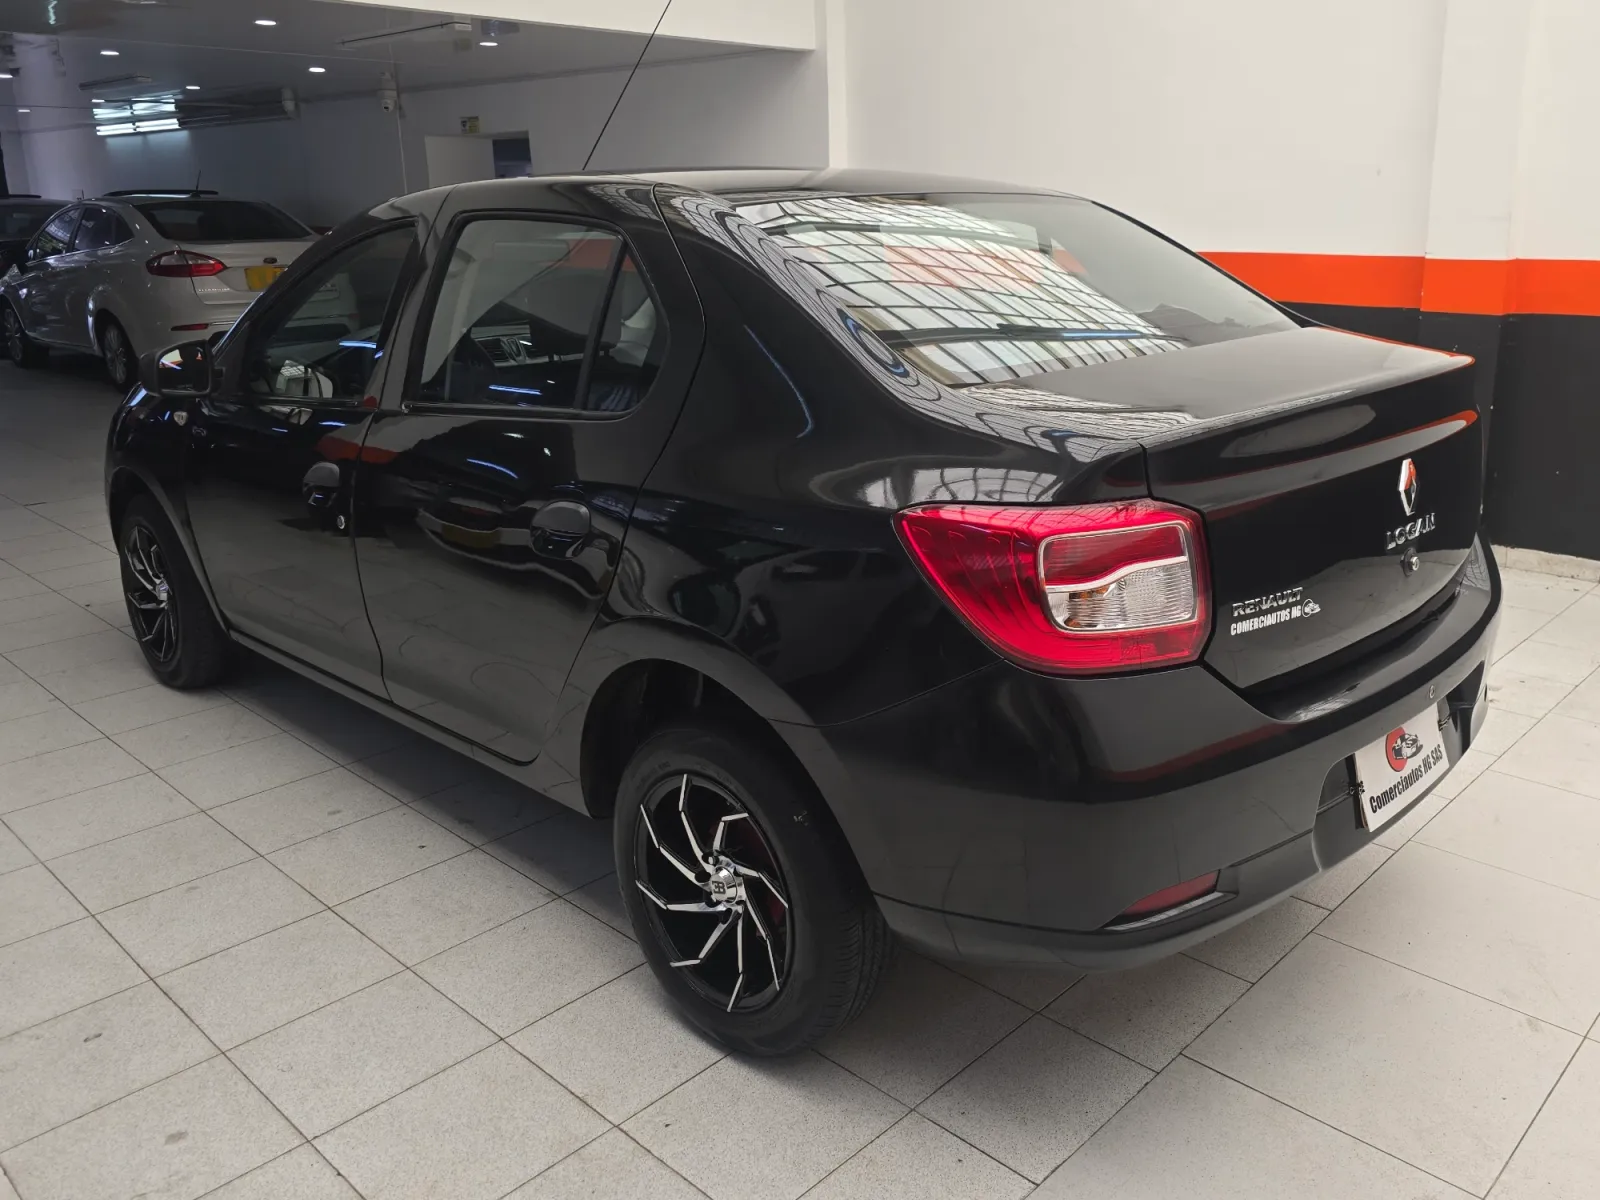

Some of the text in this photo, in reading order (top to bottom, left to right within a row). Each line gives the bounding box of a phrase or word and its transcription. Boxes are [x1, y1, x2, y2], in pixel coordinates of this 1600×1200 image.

[1386, 512, 1436, 550] LOGAN
[1232, 587, 1303, 617] RENAULT
[1230, 608, 1290, 636] COMERCIAUTOS
[1369, 766, 1423, 814] Comerciautos
[1431, 744, 1443, 766] SAS
